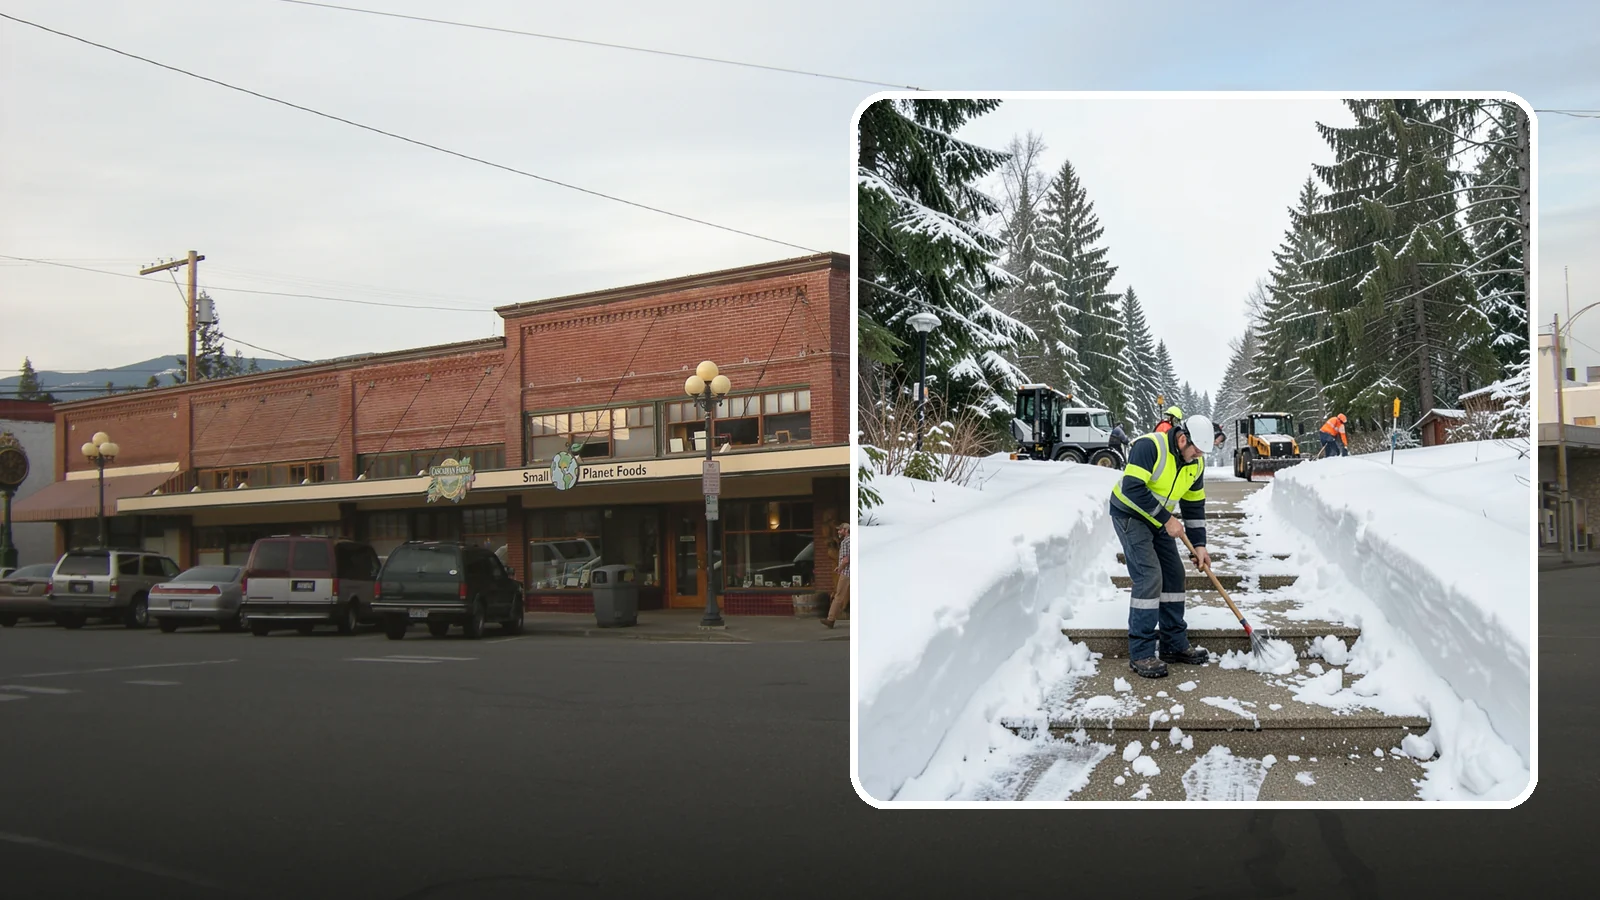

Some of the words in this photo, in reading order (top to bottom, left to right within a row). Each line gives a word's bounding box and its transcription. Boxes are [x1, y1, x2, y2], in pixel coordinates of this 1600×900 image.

[523, 471, 548, 482] Small
[583, 468, 614, 479] Planet
[617, 464, 646, 477] Foods
